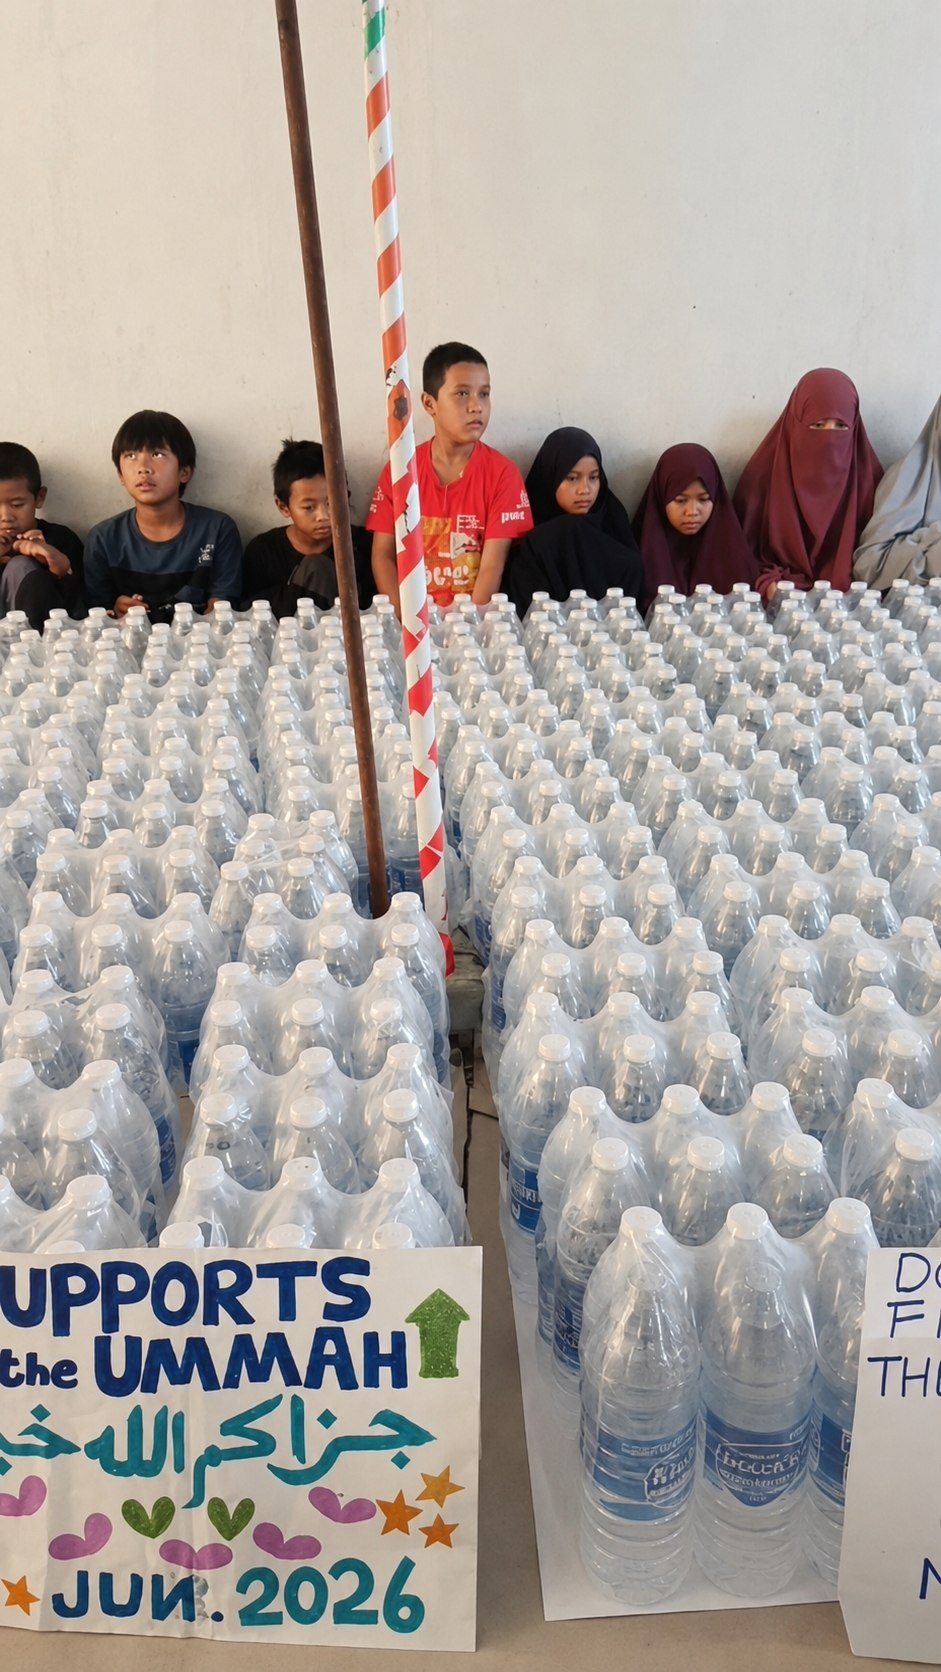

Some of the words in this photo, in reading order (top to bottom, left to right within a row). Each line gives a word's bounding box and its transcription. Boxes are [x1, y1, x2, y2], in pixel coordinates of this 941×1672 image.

[895, 1252, 941, 1293] D
[886, 1299, 941, 1339] F
[0, 1349, 78, 1389] the
[94, 1326, 408, 1398] UMMAH
[867, 1355, 941, 1398] TH
[84, 1404, 186, 1478] الله
[236, 1556, 426, 1634] 2026
